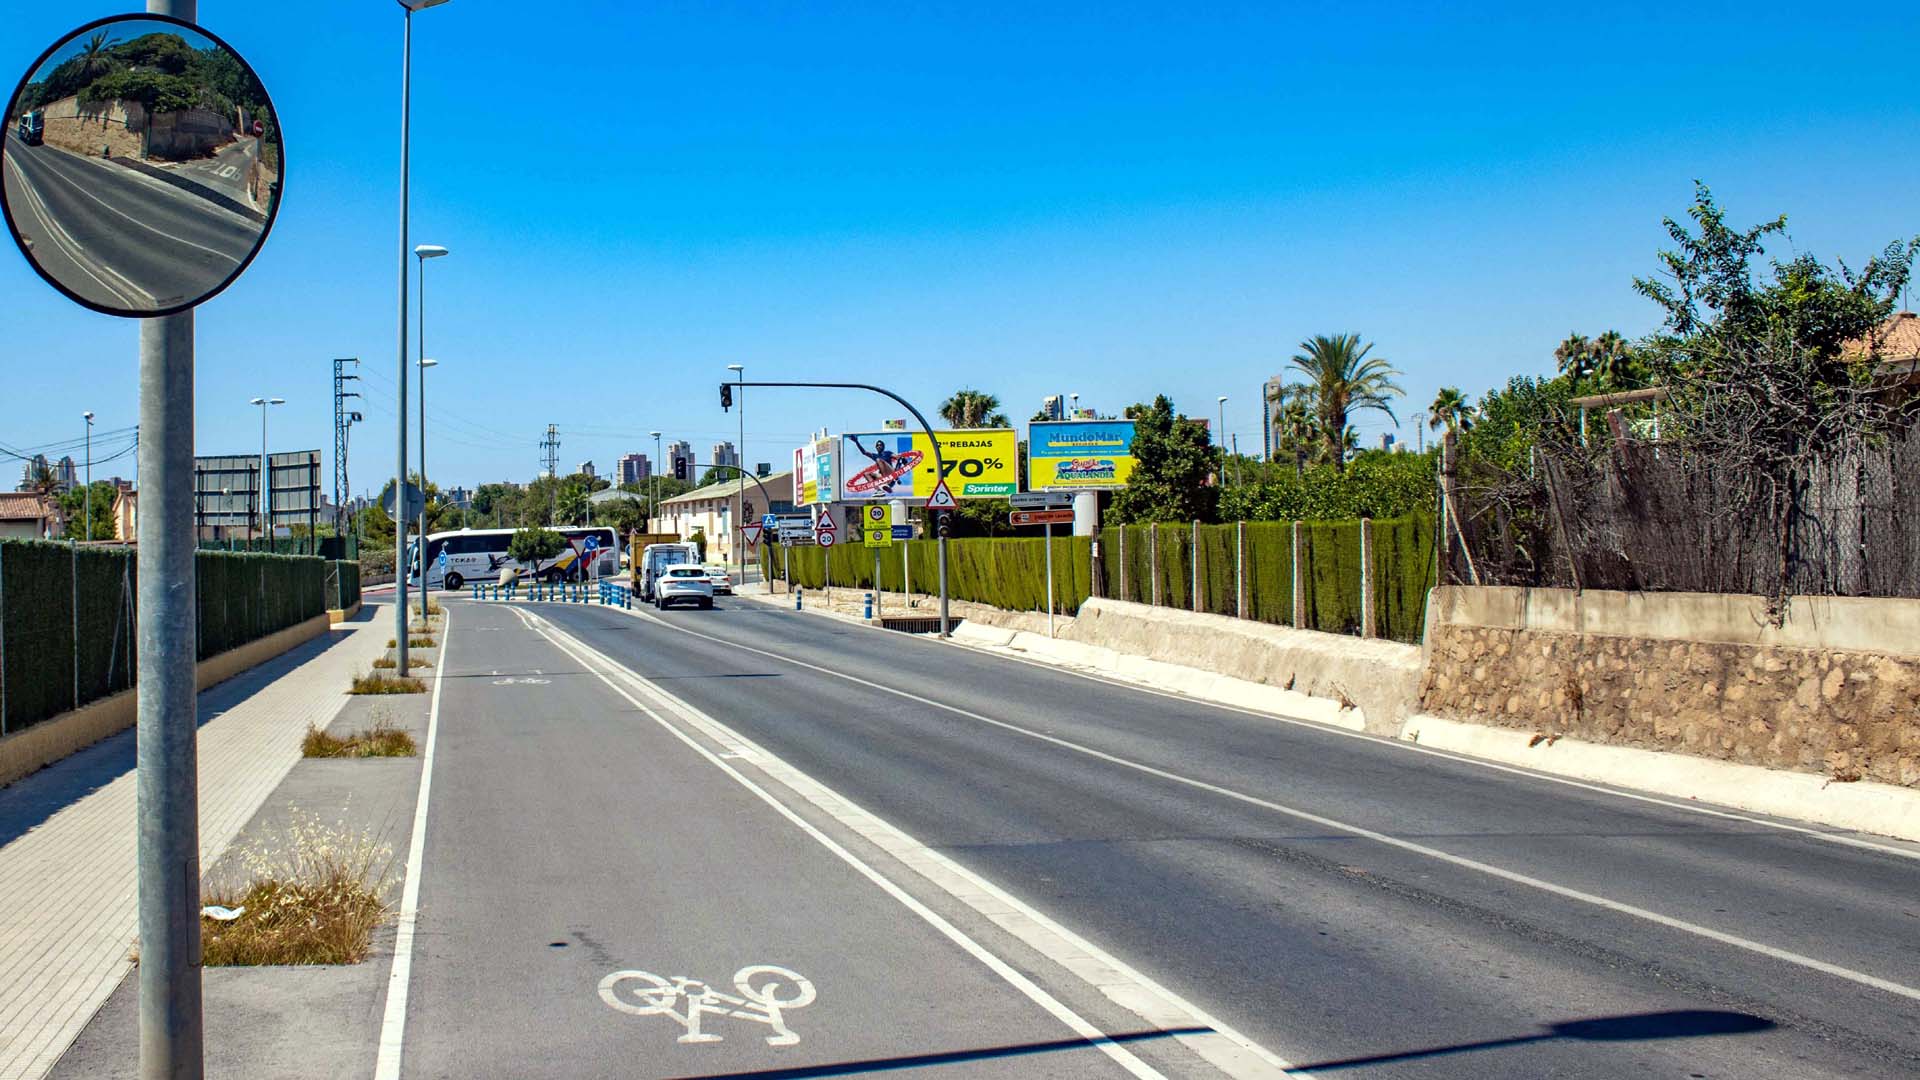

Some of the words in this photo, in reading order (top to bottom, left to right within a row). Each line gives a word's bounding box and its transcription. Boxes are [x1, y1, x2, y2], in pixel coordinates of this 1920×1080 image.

[1049, 432, 1123, 442] MundoMar
[950, 440, 993, 448] REBAJAS
[967, 484, 1008, 493] Sprinter
[822, 535, 832, 543] 20
